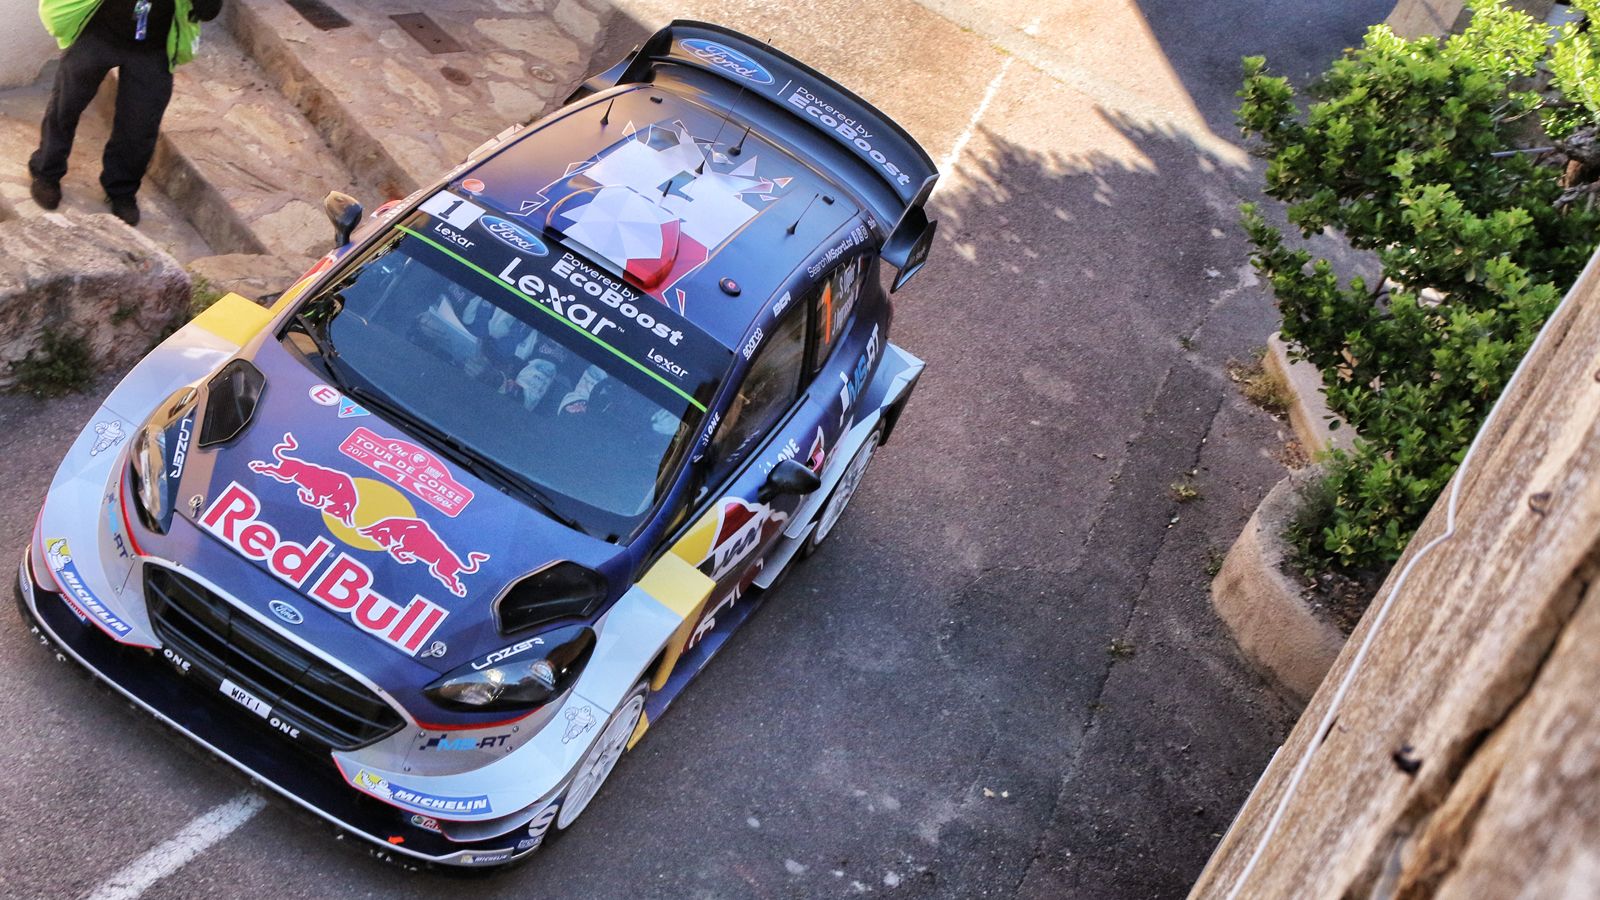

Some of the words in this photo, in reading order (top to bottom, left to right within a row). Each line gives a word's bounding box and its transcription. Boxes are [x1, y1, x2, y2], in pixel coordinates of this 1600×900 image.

[695, 44, 757, 79] Ford
[796, 86, 856, 126] Powered
[855, 124, 873, 138] by
[788, 93, 910, 186] EcoBoost
[438, 200, 464, 220] 1
[434, 222, 475, 248] Lexar
[489, 222, 536, 250] Ford
[562, 252, 622, 291] Powered
[621, 287, 639, 301] by
[551, 259, 684, 346] EcoBoost
[743, 327, 764, 360] sparco
[647, 348, 689, 377] Lexar
[314, 388, 336, 402] E
[708, 412, 720, 435] ONE
[346, 444, 369, 459] 2017
[777, 438, 800, 461] ONE
[356, 436, 393, 461] TOUR
[395, 462, 416, 474] DE
[418, 473, 464, 503] CORSE
[201, 482, 333, 586] Red
[309, 554, 447, 655] Bull
[63, 571, 129, 632] MICHELIN
[163, 648, 192, 671] ONE
[231, 687, 253, 706] WRT
[269, 717, 300, 739] ONE
[395, 789, 488, 812] MICHELIN
